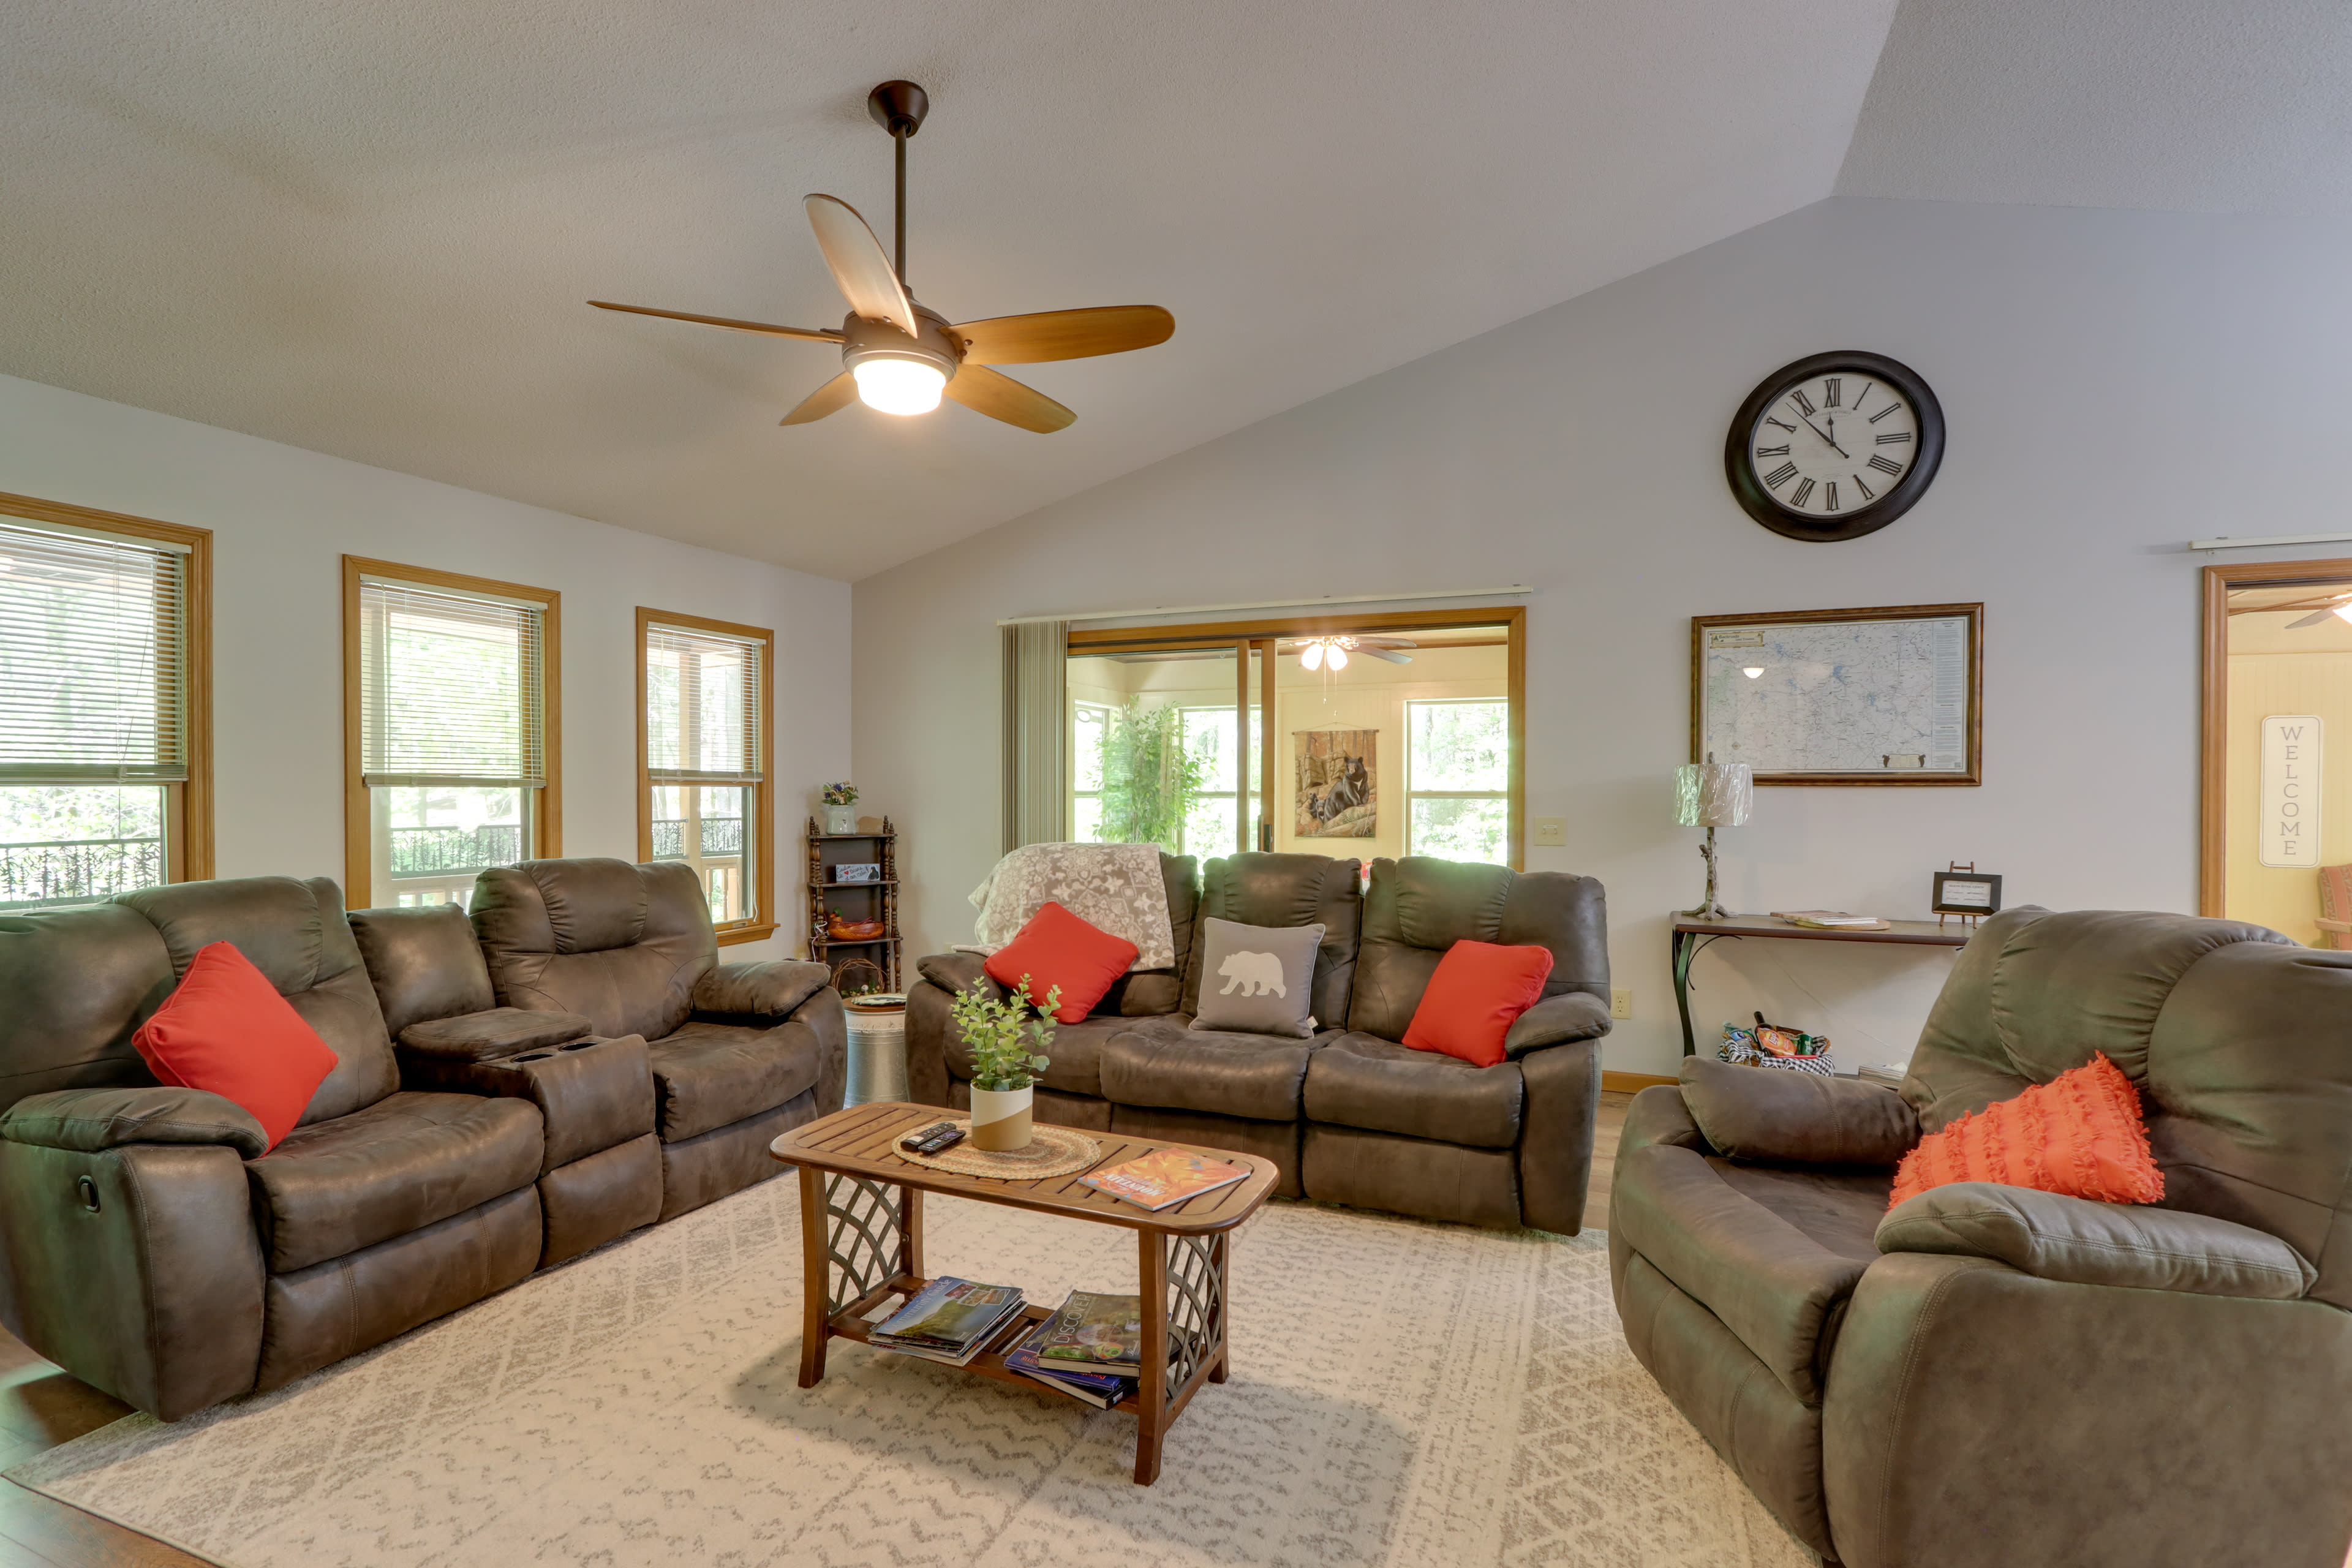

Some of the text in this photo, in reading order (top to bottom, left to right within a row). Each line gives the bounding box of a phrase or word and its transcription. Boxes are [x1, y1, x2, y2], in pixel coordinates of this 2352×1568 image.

[1790, 390, 1817, 417] XI
[1824, 377, 1842, 409] XII
[1766, 415, 1797, 433] X
[1869, 402, 1901, 424] II
[1757, 444, 1790, 458] IX
[1876, 432, 1912, 445] III
[1764, 461, 1800, 490] VIII
[1853, 474, 1875, 500] V
[1790, 477, 1817, 507] VII
[1825, 481, 1840, 511] VI
[2280, 726, 2304, 855] WELCOME
[1102, 1173, 1166, 1196] MOUNTAIN
[883, 1279, 953, 1330] Community Guide
[1053, 1294, 1093, 1343] DISCOVER
